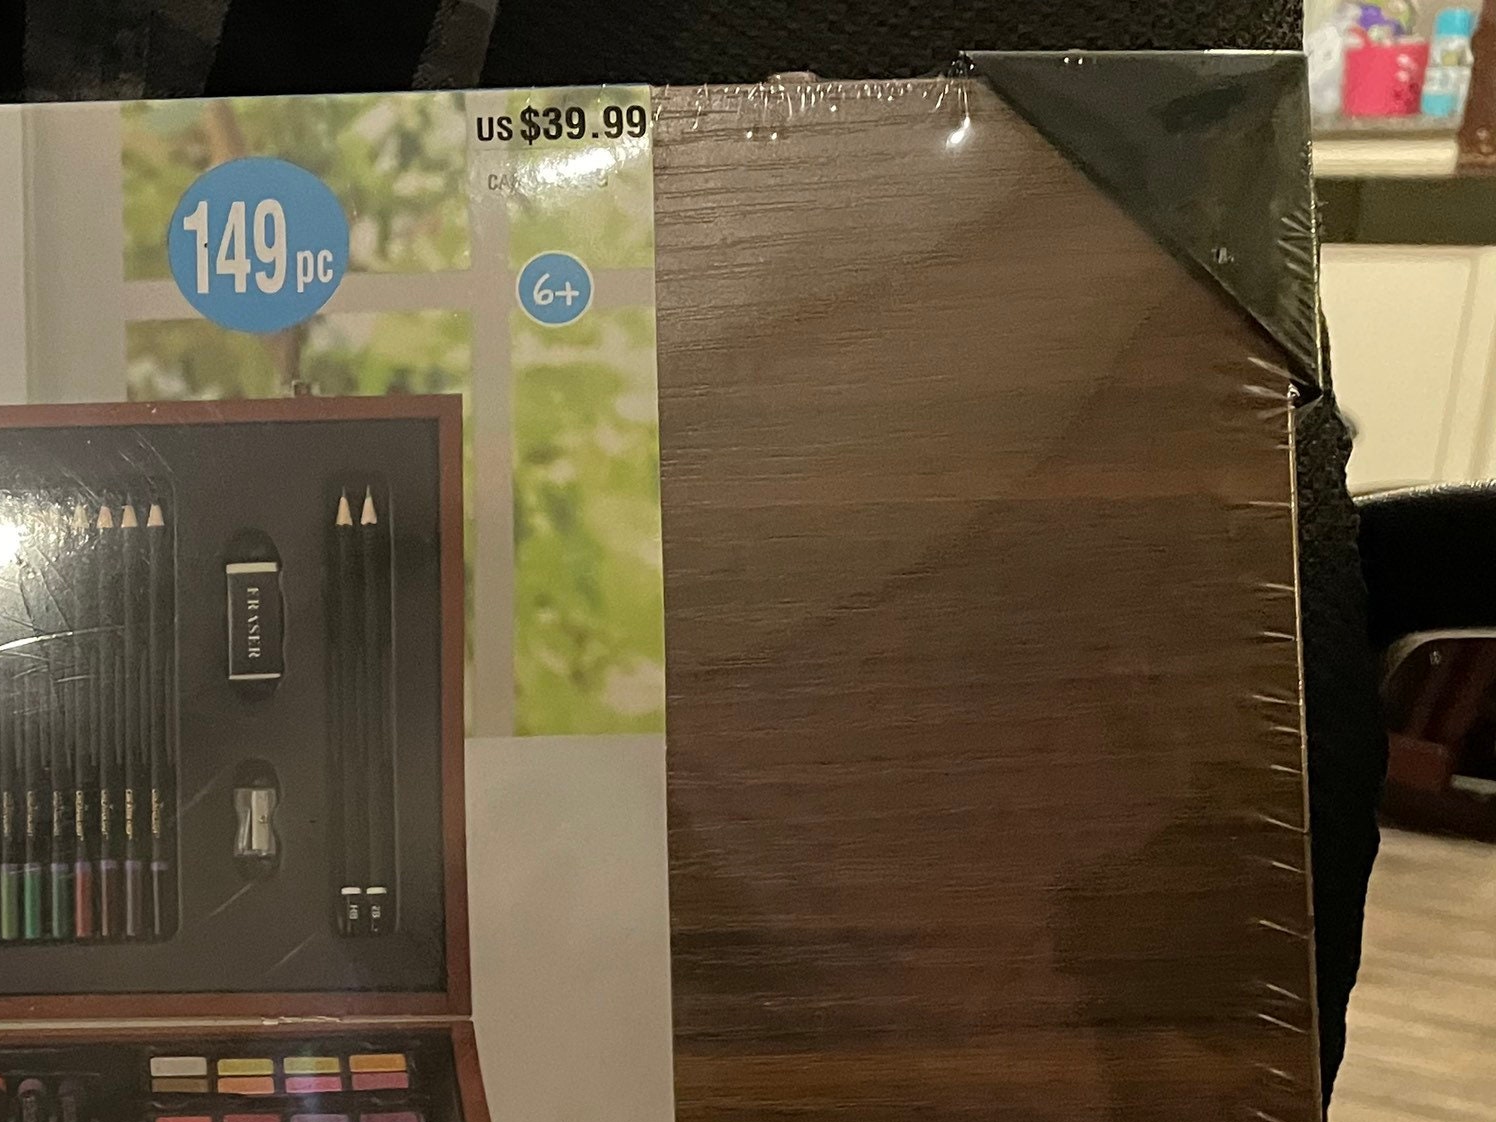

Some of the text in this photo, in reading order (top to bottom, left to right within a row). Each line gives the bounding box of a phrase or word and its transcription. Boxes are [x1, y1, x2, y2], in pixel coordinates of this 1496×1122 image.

[477, 105, 647, 145] US $39.99
[184, 199, 334, 294] 149 pc
[533, 273, 580, 306] 6+
[247, 587, 261, 658] ERASER
